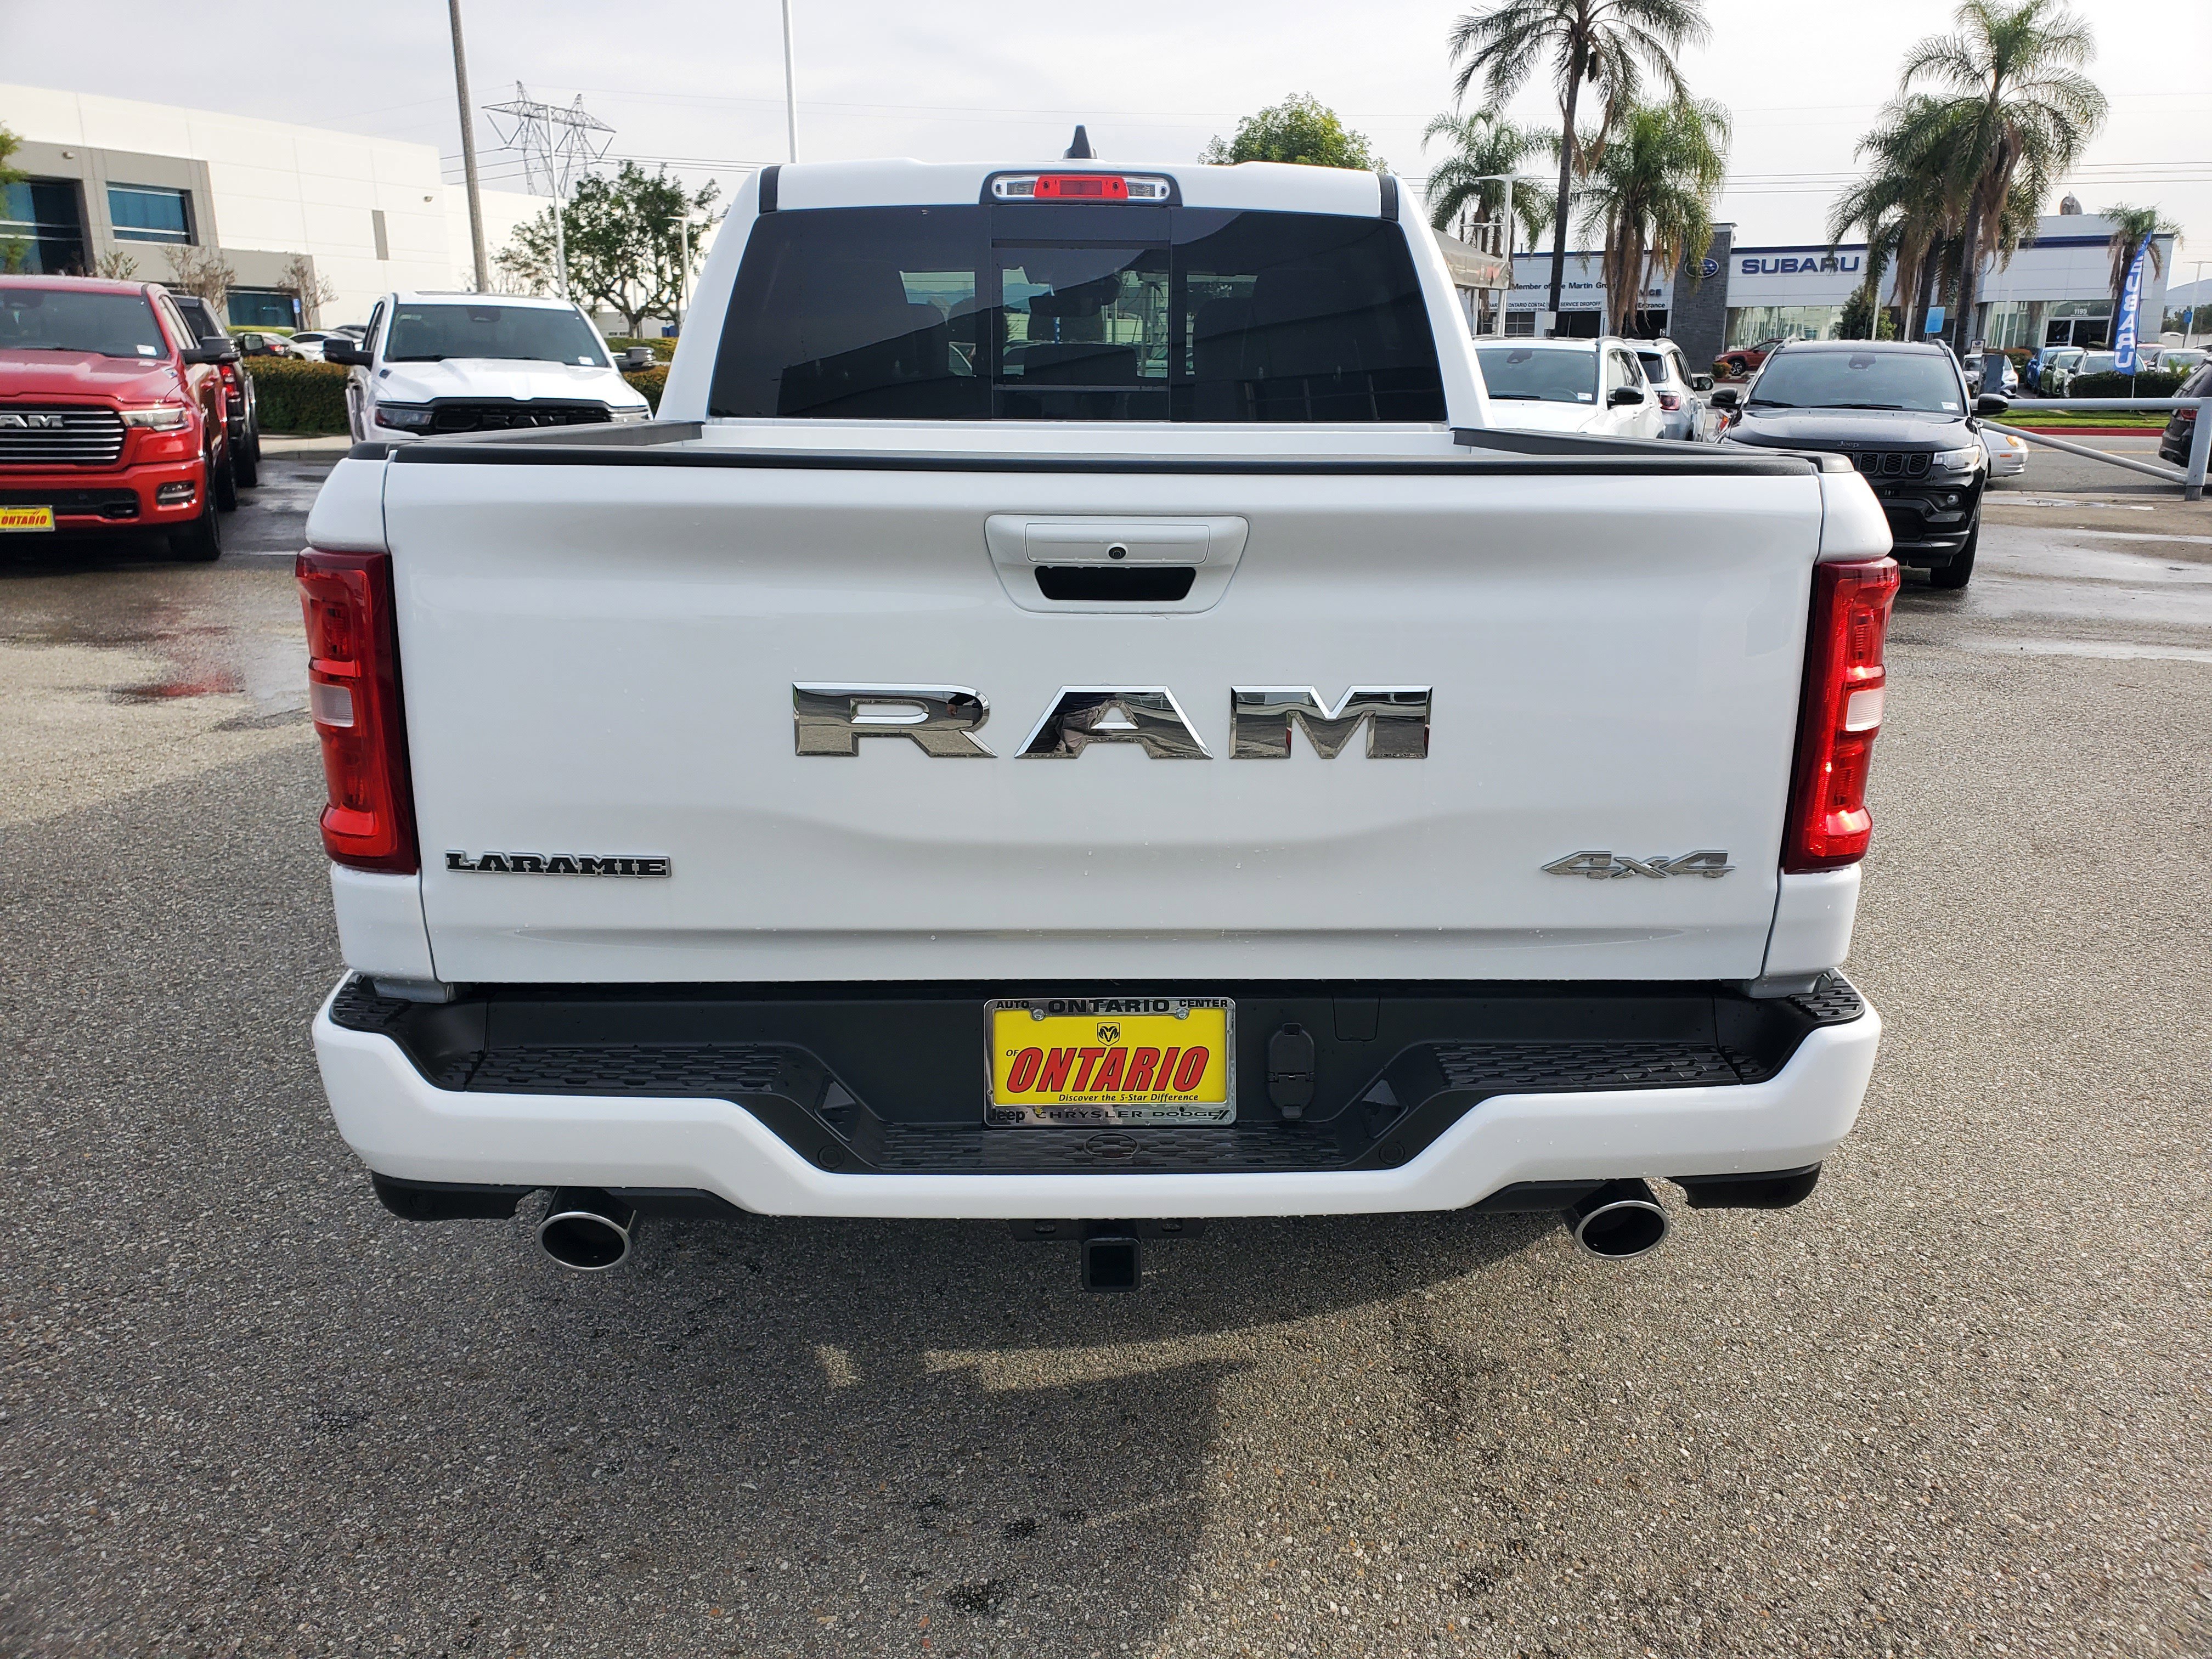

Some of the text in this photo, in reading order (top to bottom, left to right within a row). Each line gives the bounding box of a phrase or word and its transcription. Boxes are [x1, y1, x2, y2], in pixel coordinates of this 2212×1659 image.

[1741, 256, 1860, 274] SUBARU
[0, 415, 63, 427] AM
[1, 515, 47, 524] ONTARIO
[793, 682, 1433, 760] RAM
[445, 850, 672, 878] LARAMIE
[1541, 850, 1736, 879] 4x4
[1048, 999, 1170, 1013] ONTARIO
[1179, 999, 1228, 1008] CENTER
[1006, 1046, 1210, 1093] ONTARIO
[1058, 1093, 1199, 1103] Discover the 5-Star Difference
[988, 1109, 1025, 1122] Jeep
[1036, 1110, 1143, 1119] CHRYSLER
